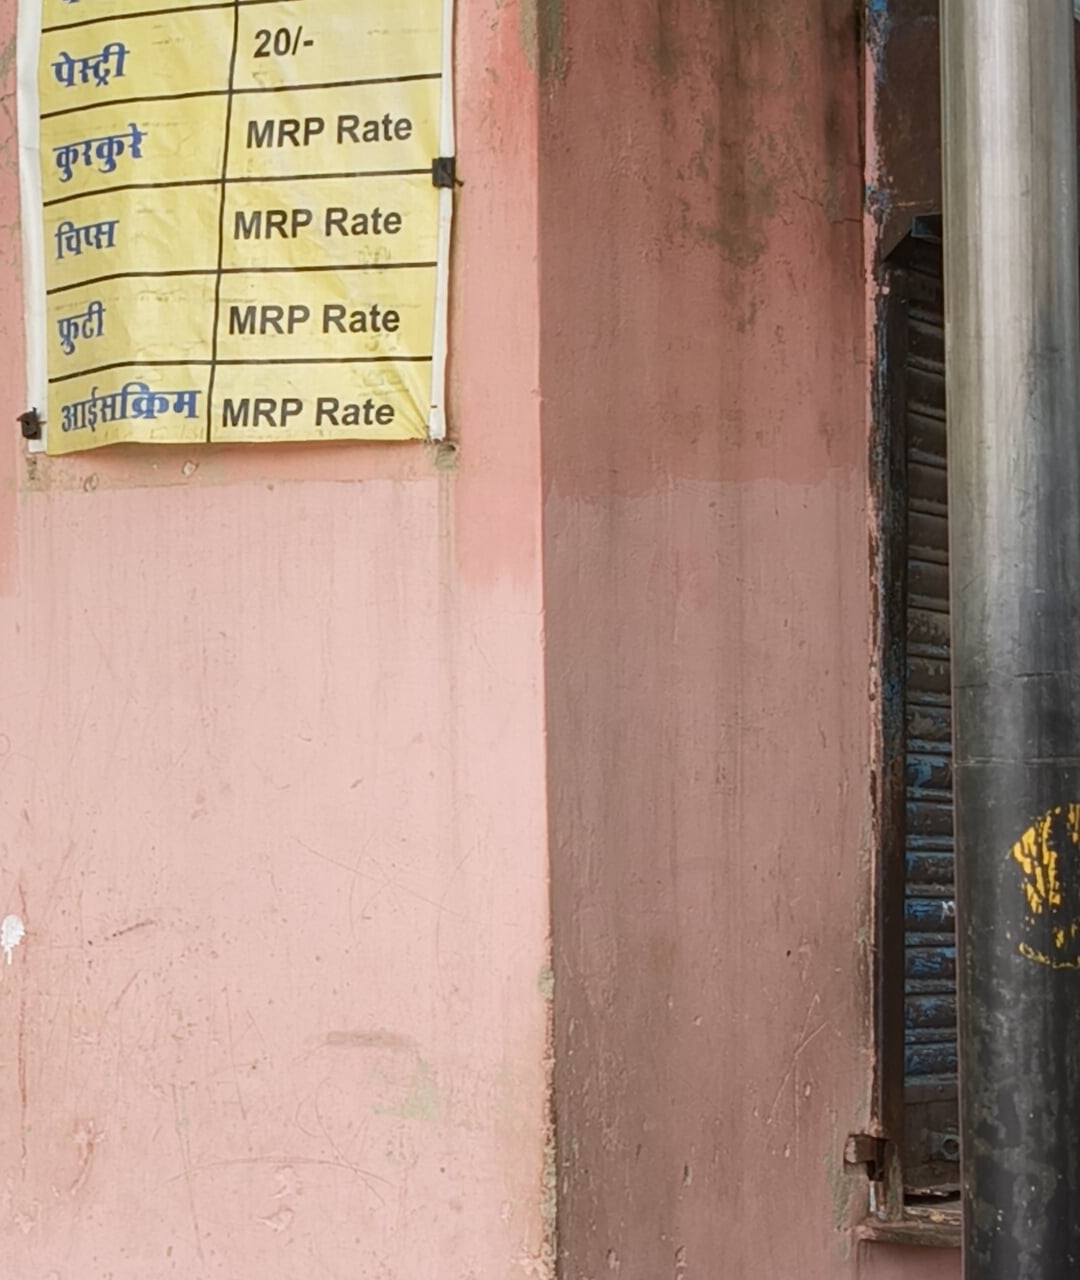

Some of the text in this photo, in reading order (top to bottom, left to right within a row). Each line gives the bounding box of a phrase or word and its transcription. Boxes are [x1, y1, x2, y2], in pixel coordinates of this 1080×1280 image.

[254, 26, 314, 59] 20/-
[51, 42, 130, 88] पेस्ट्री
[246, 112, 413, 149] MRP Rate
[52, 122, 148, 183] कुरकुरे
[54, 220, 120, 260] चिप्स
[233, 206, 403, 241] MRP Rate
[228, 303, 401, 335] MRP Rate
[61, 381, 202, 433] आईसक्रिम
[221, 395, 395, 428] MRP Rate
